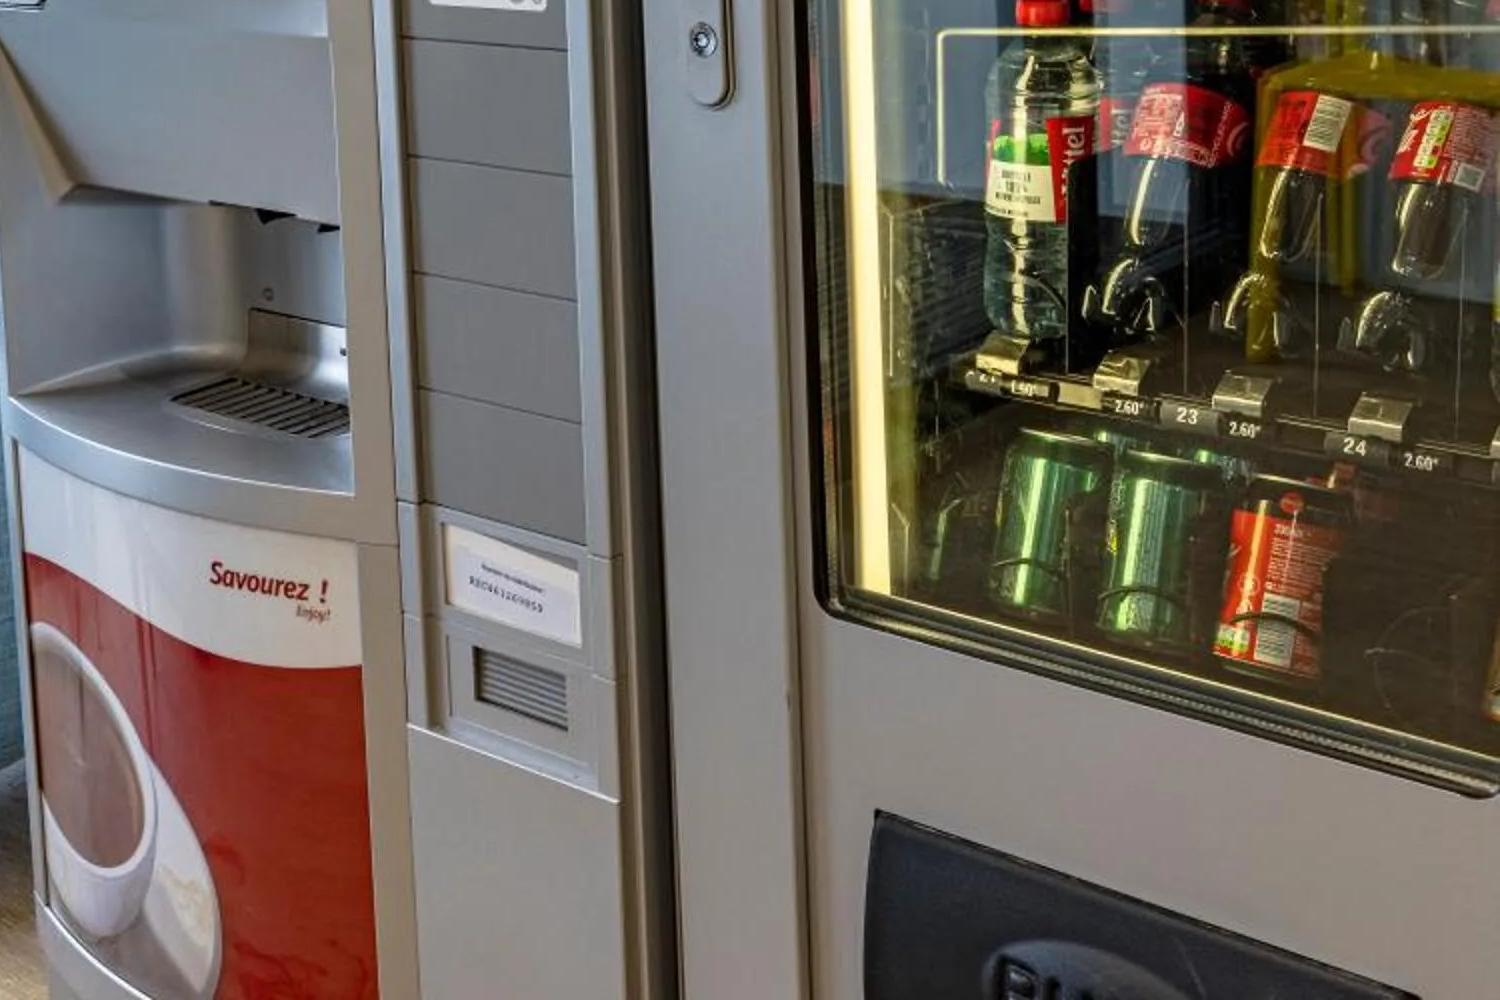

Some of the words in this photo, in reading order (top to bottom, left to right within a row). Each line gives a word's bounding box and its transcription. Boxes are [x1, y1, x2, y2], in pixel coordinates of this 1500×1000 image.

[1176, 406, 1199, 426] 23
[1343, 437, 1368, 456] 24
[209, 561, 310, 602] Savourez
[319, 579, 329, 604] !
